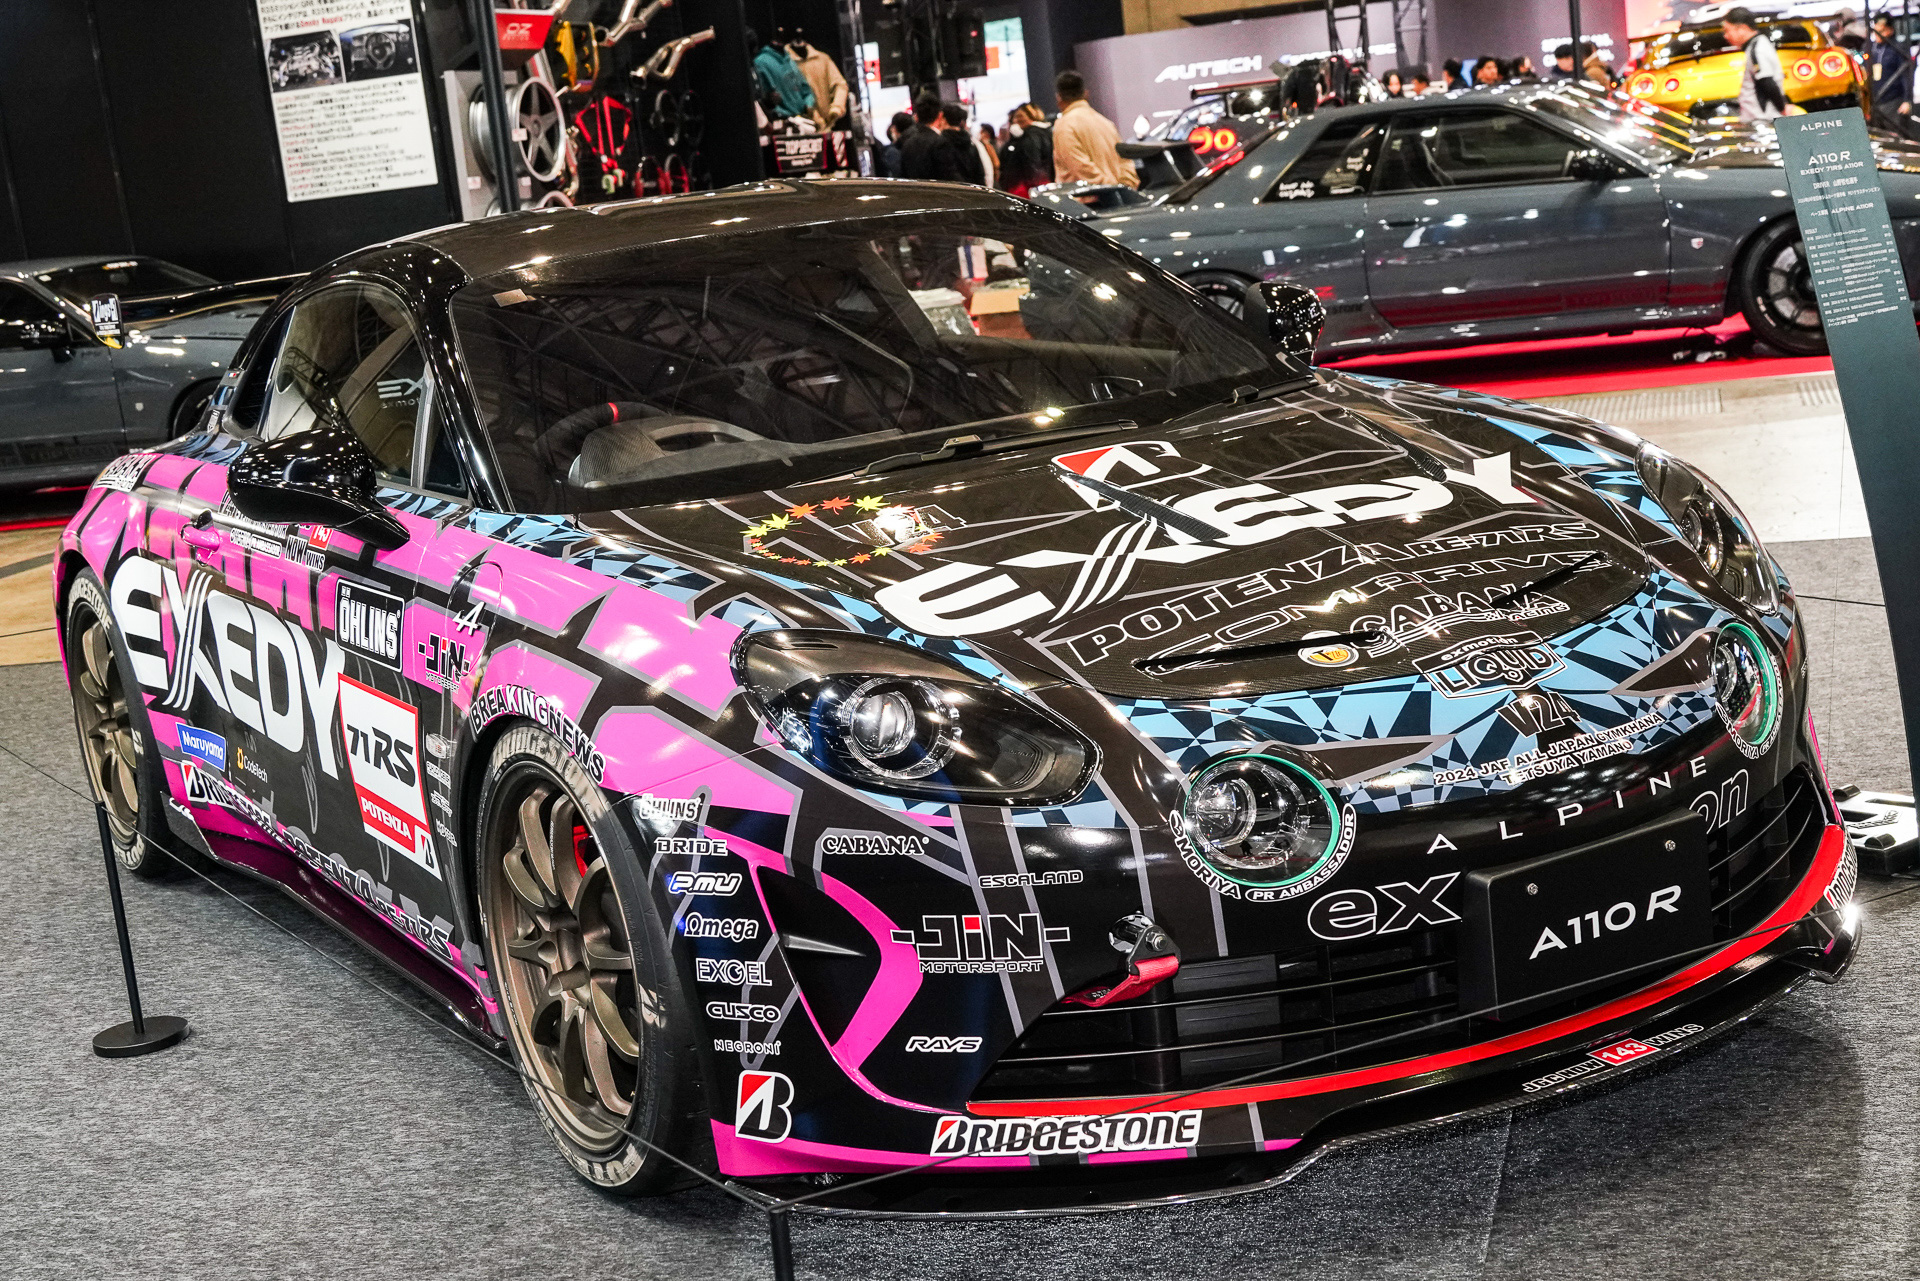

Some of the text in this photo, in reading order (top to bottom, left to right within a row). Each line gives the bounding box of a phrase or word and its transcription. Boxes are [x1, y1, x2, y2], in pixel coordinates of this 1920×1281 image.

[1154, 55, 1262, 83] AUTECH
[1800, 119, 1843, 132] ALPINE
[1800, 167, 1824, 176] EXEDY
[1808, 150, 1851, 166] A110 R
[1831, 205, 1856, 215] ALPINE
[285, 535, 326, 571] NOW WINS
[874, 451, 1539, 638] EXEDY
[1067, 522, 1601, 667] POTENZA RE-71RS
[1440, 635, 1520, 662] exmotion
[110, 555, 345, 781] EXEDY
[1495, 691, 1583, 739] V24
[182, 731, 224, 762] Maruyama
[347, 723, 416, 788] 71RS
[1434, 712, 1665, 786] 2024 JAF ALL JAPAN GYMKHANA
[1501, 740, 1634, 786] TETSUYA YAMANO
[243, 755, 268, 783] CodeTech
[360, 796, 413, 842] POTENZA
[1427, 755, 1707, 855] ALPINE
[654, 838, 729, 857] BRIDE
[821, 834, 925, 856] CABANA
[1174, 811, 1358, 902] MORIYA PR AMBASSADOR
[978, 870, 1084, 888] ESCALAND
[1307, 871, 1462, 942] ex
[1529, 884, 1682, 960] A110 R
[919, 960, 1044, 974] MOTORSPORT
[706, 1002, 781, 1023] CUSCO
[905, 1036, 982, 1053] RAYS
[1560, 1058, 1606, 1084] NOW
[1601, 1042, 1649, 1062] 143
[1643, 1023, 1705, 1048] WINS
[931, 1112, 1201, 1157] BRIDGESTONE
